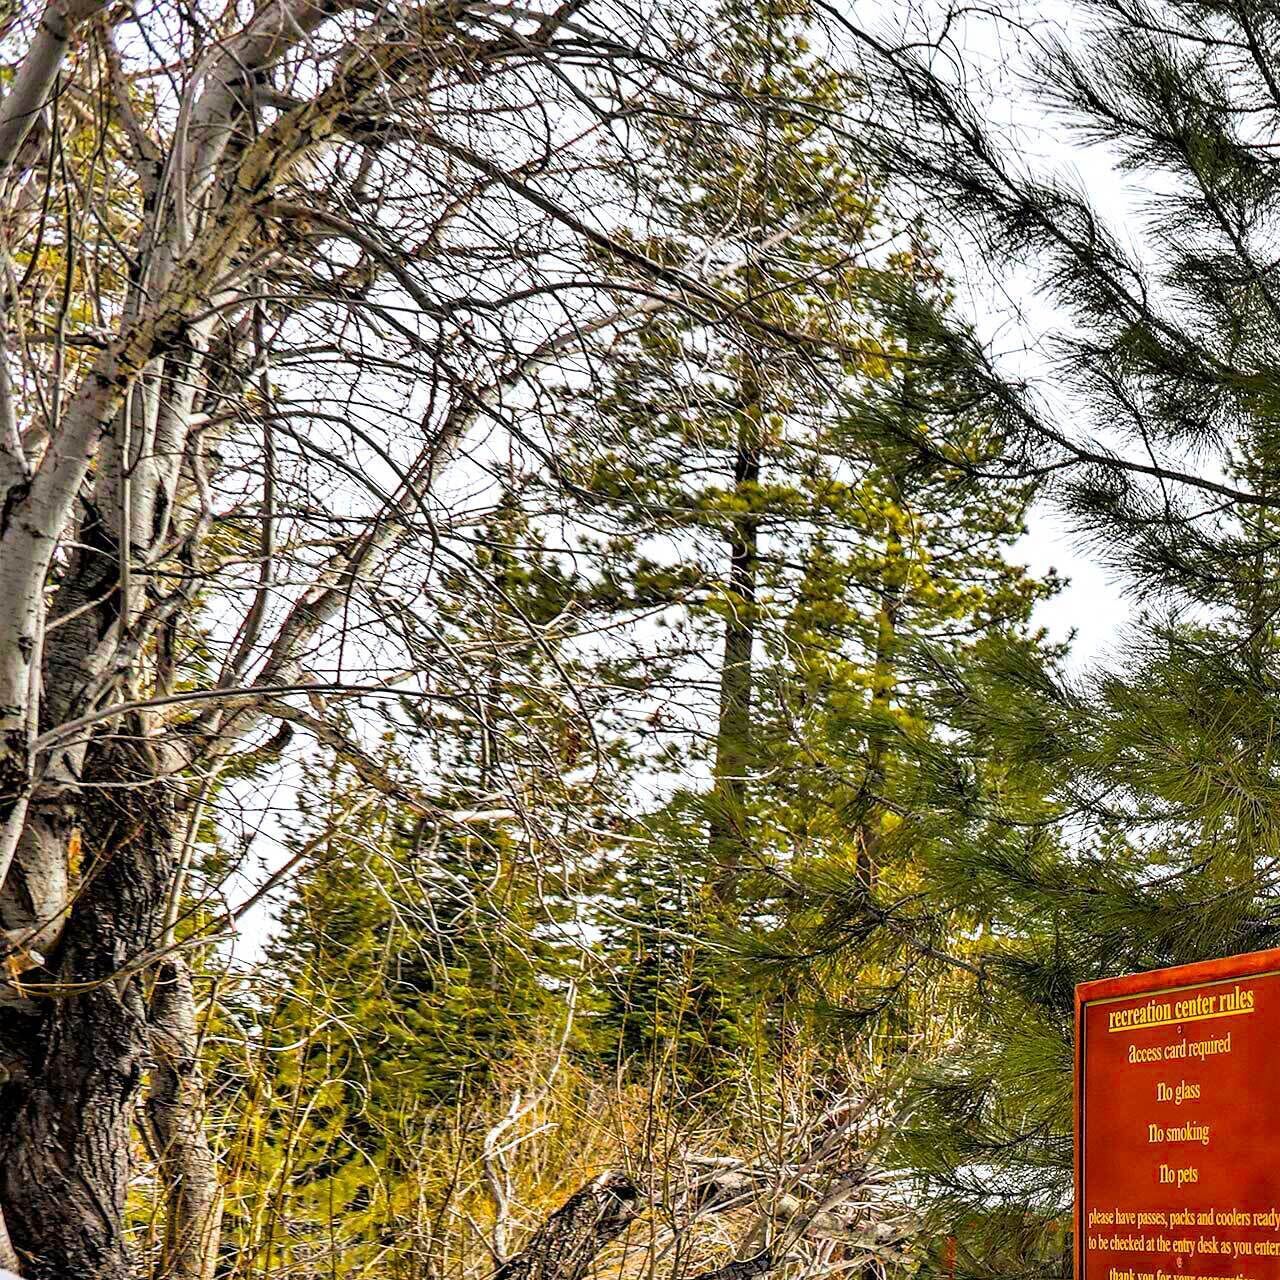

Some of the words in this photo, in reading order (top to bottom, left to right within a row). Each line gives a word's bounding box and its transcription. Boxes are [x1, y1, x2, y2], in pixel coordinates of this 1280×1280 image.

[1109, 1000, 1171, 1028] recreation
[1175, 994, 1216, 1018] center
[1219, 986, 1254, 1011] rules
[1164, 1038, 1187, 1059] card
[1188, 1031, 1231, 1060] required
[1175, 1079, 1200, 1105] glass
[1166, 1121, 1210, 1145] smoking
[1177, 1165, 1198, 1188] pets
[1088, 1207, 1114, 1228] please
[1115, 1207, 1136, 1224] have
[1137, 1212, 1168, 1229] passes,
[1169, 1207, 1196, 1229] packs
[1197, 1207, 1214, 1226] and
[1215, 1207, 1251, 1226] coolers
[1252, 1207, 1280, 1231] ready
[1088, 1236, 1097, 1250] to
[1098, 1233, 1109, 1250] be
[1109, 1233, 1145, 1251] checked
[1145, 1237, 1155, 1251] at
[1156, 1235, 1171, 1252] the
[1172, 1237, 1195, 1257] entry
[1197, 1235, 1219, 1254] desk
[1220, 1241, 1232, 1254] as
[1233, 1241, 1252, 1259] you
